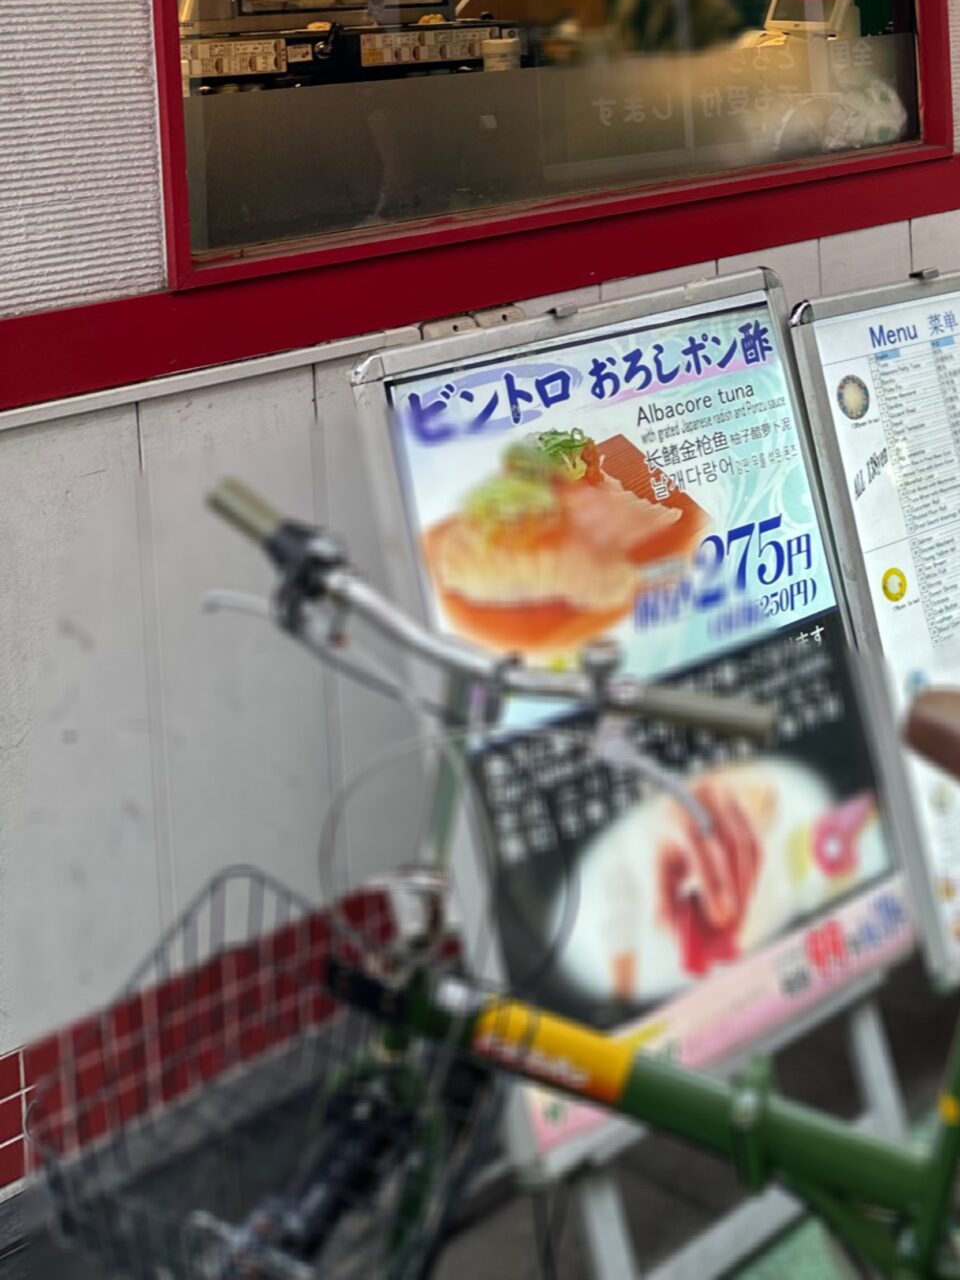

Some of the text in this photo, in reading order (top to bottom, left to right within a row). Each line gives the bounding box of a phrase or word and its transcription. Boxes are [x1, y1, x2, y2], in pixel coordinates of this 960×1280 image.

[868, 324, 919, 349] Menu
[927, 310, 959, 336] 菜单
[588, 318, 776, 400] おろしポン酢
[636, 384, 755, 427] Albacore tuna
[658, 424, 681, 443] grated
[681, 415, 713, 435] Japanese
[732, 408, 747, 419] and
[745, 400, 769, 418] Ponzu
[694, 512, 813, 610] 275円
